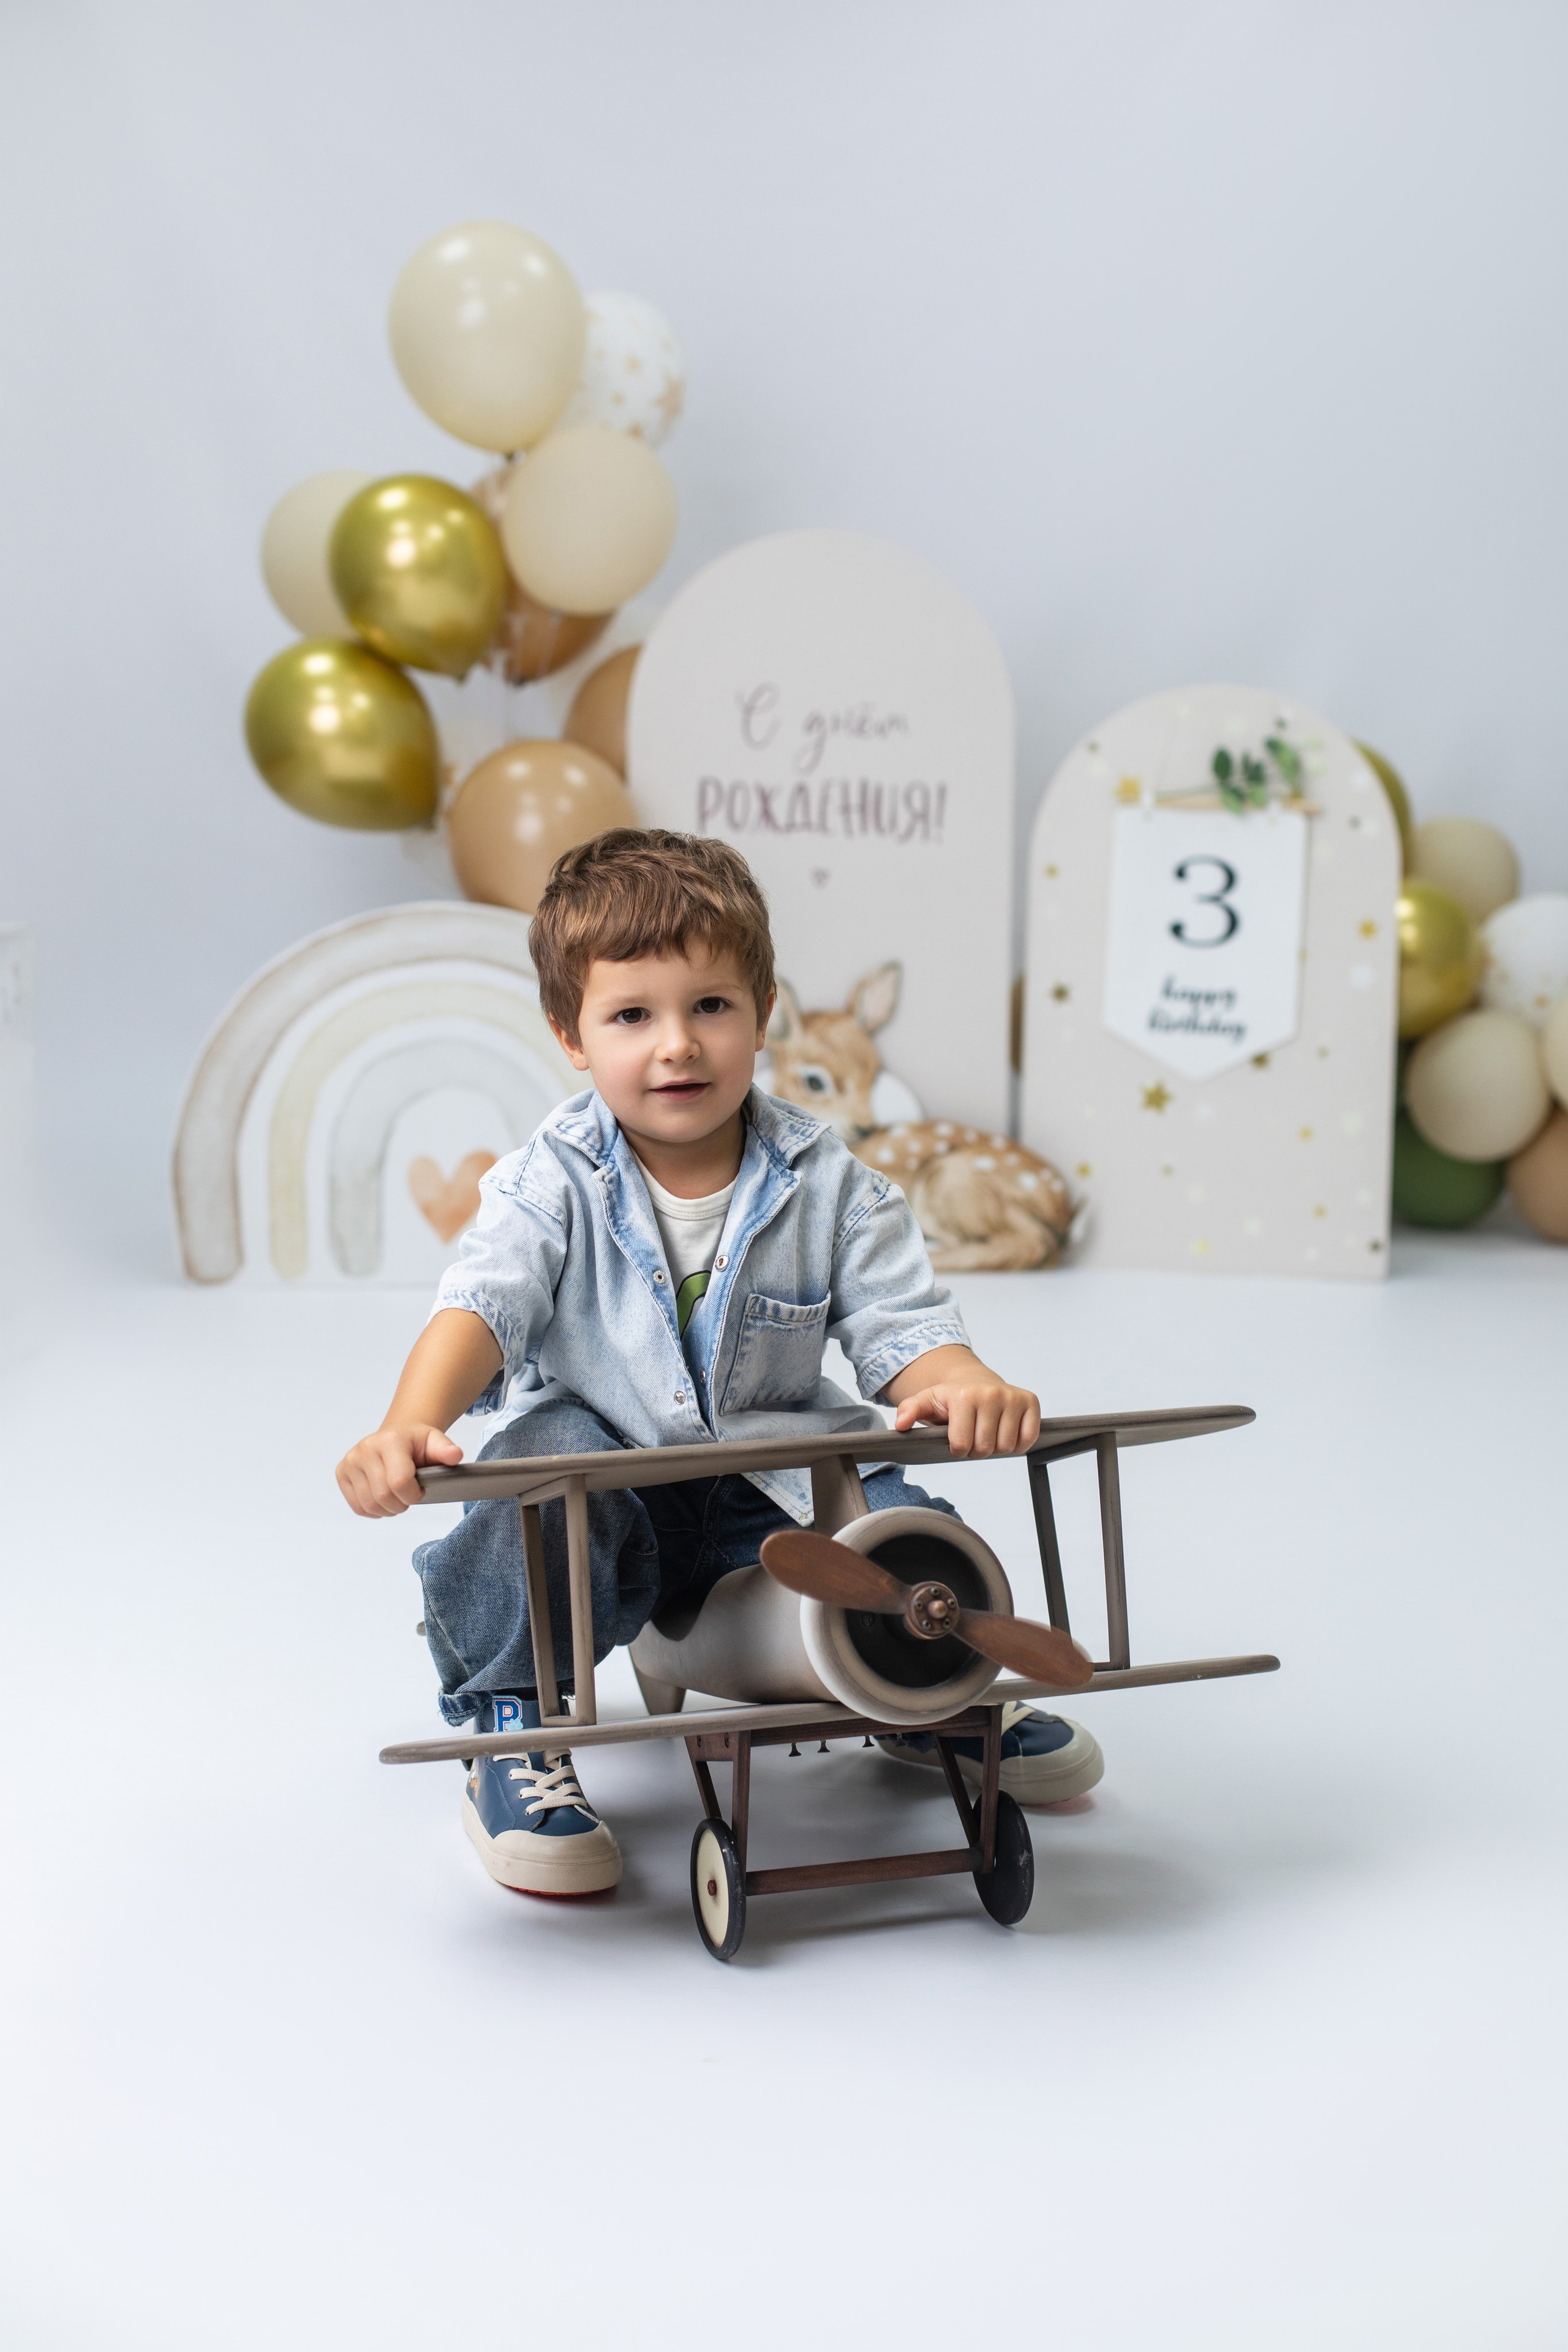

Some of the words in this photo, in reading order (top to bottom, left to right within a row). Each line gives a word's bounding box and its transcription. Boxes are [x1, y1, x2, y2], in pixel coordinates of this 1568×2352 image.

[697, 775, 947, 844] РОЖДЕНИЯ!
[1169, 854, 1240, 949] 3
[1162, 974, 1236, 1008] happy
[1147, 1005, 1247, 1044] birthday
